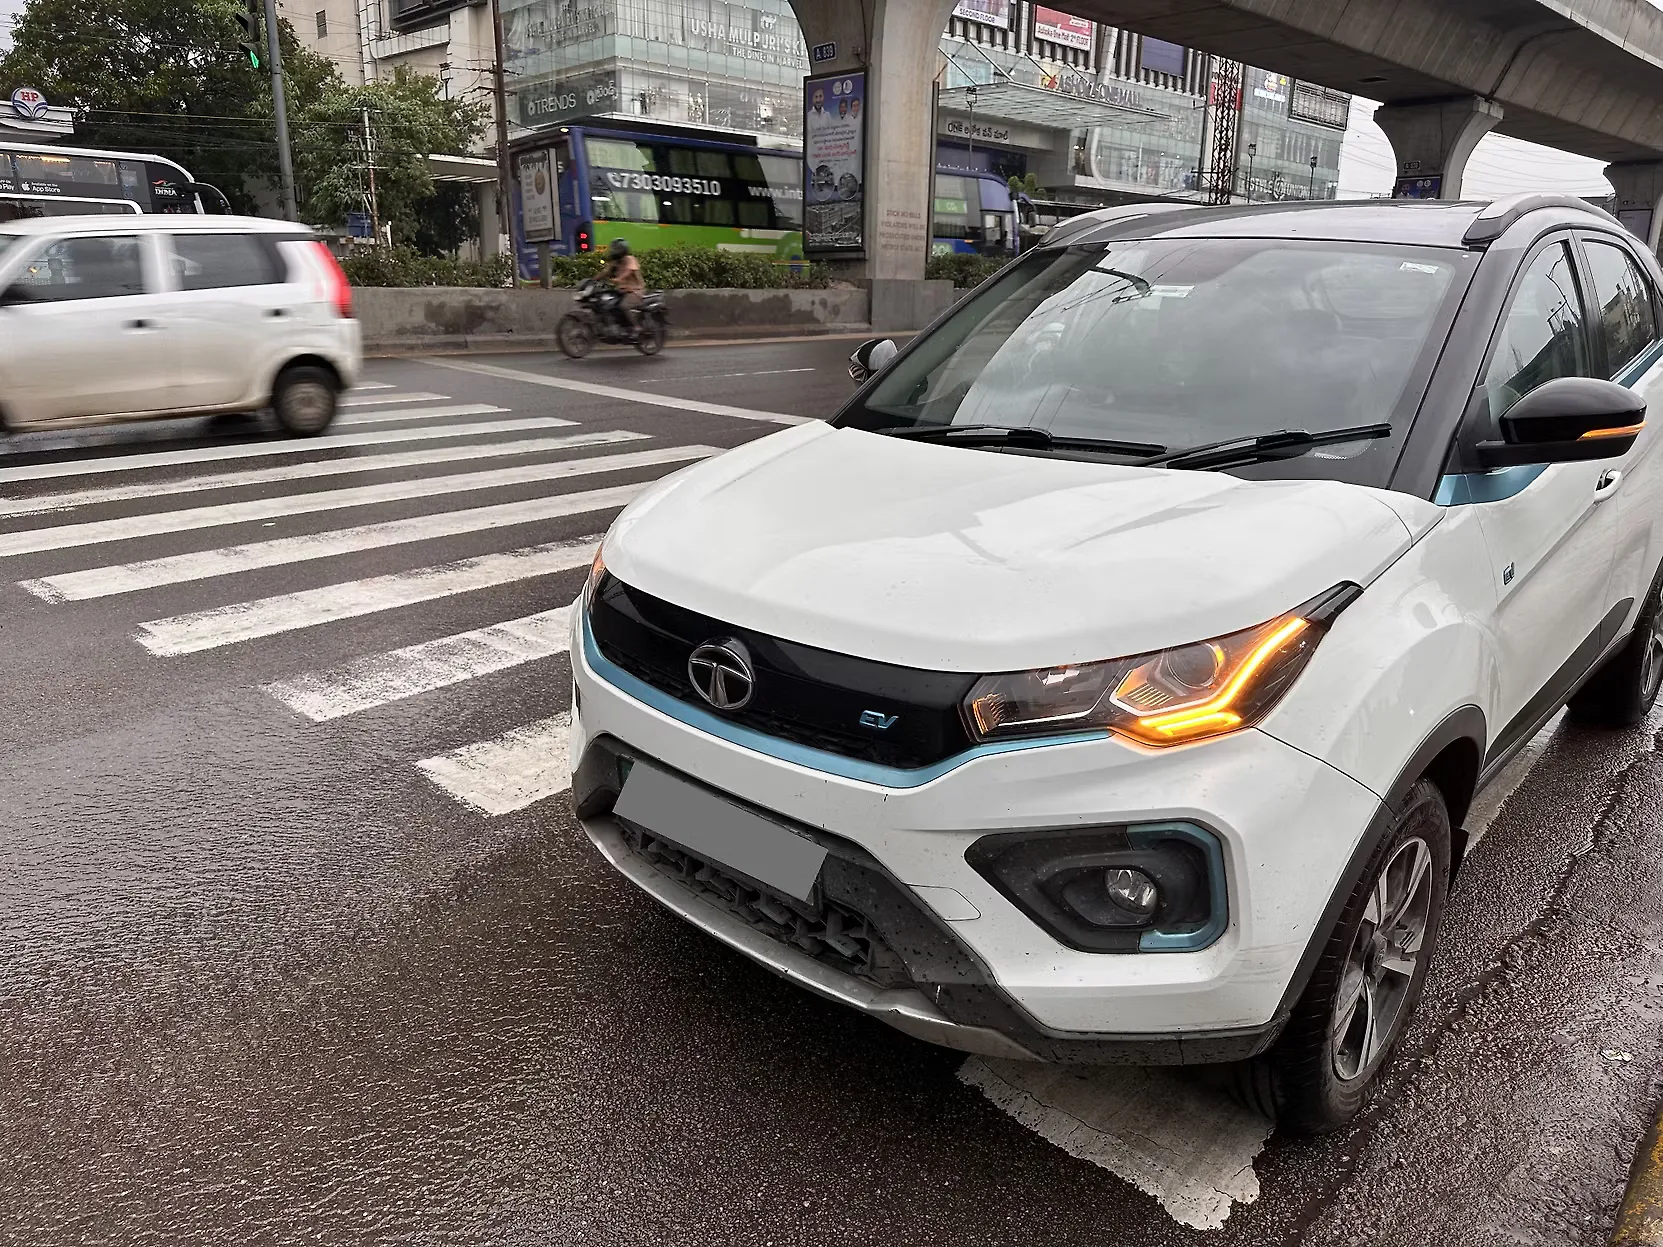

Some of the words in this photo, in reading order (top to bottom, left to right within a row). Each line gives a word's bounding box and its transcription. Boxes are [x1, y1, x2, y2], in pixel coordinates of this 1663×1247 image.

[959, 8, 980, 19] SECOND
[980, 13, 995, 23] FLOOR
[691, 18, 726, 40] USHA
[732, 47, 746, 58] THE
[20, 91, 39, 102] HP
[535, 93, 577, 114] TRENDS
[948, 122, 963, 133] ONE
[32, 185, 45, 193] App
[620, 172, 722, 196] 7303093510
[859, 709, 900, 729] EV
